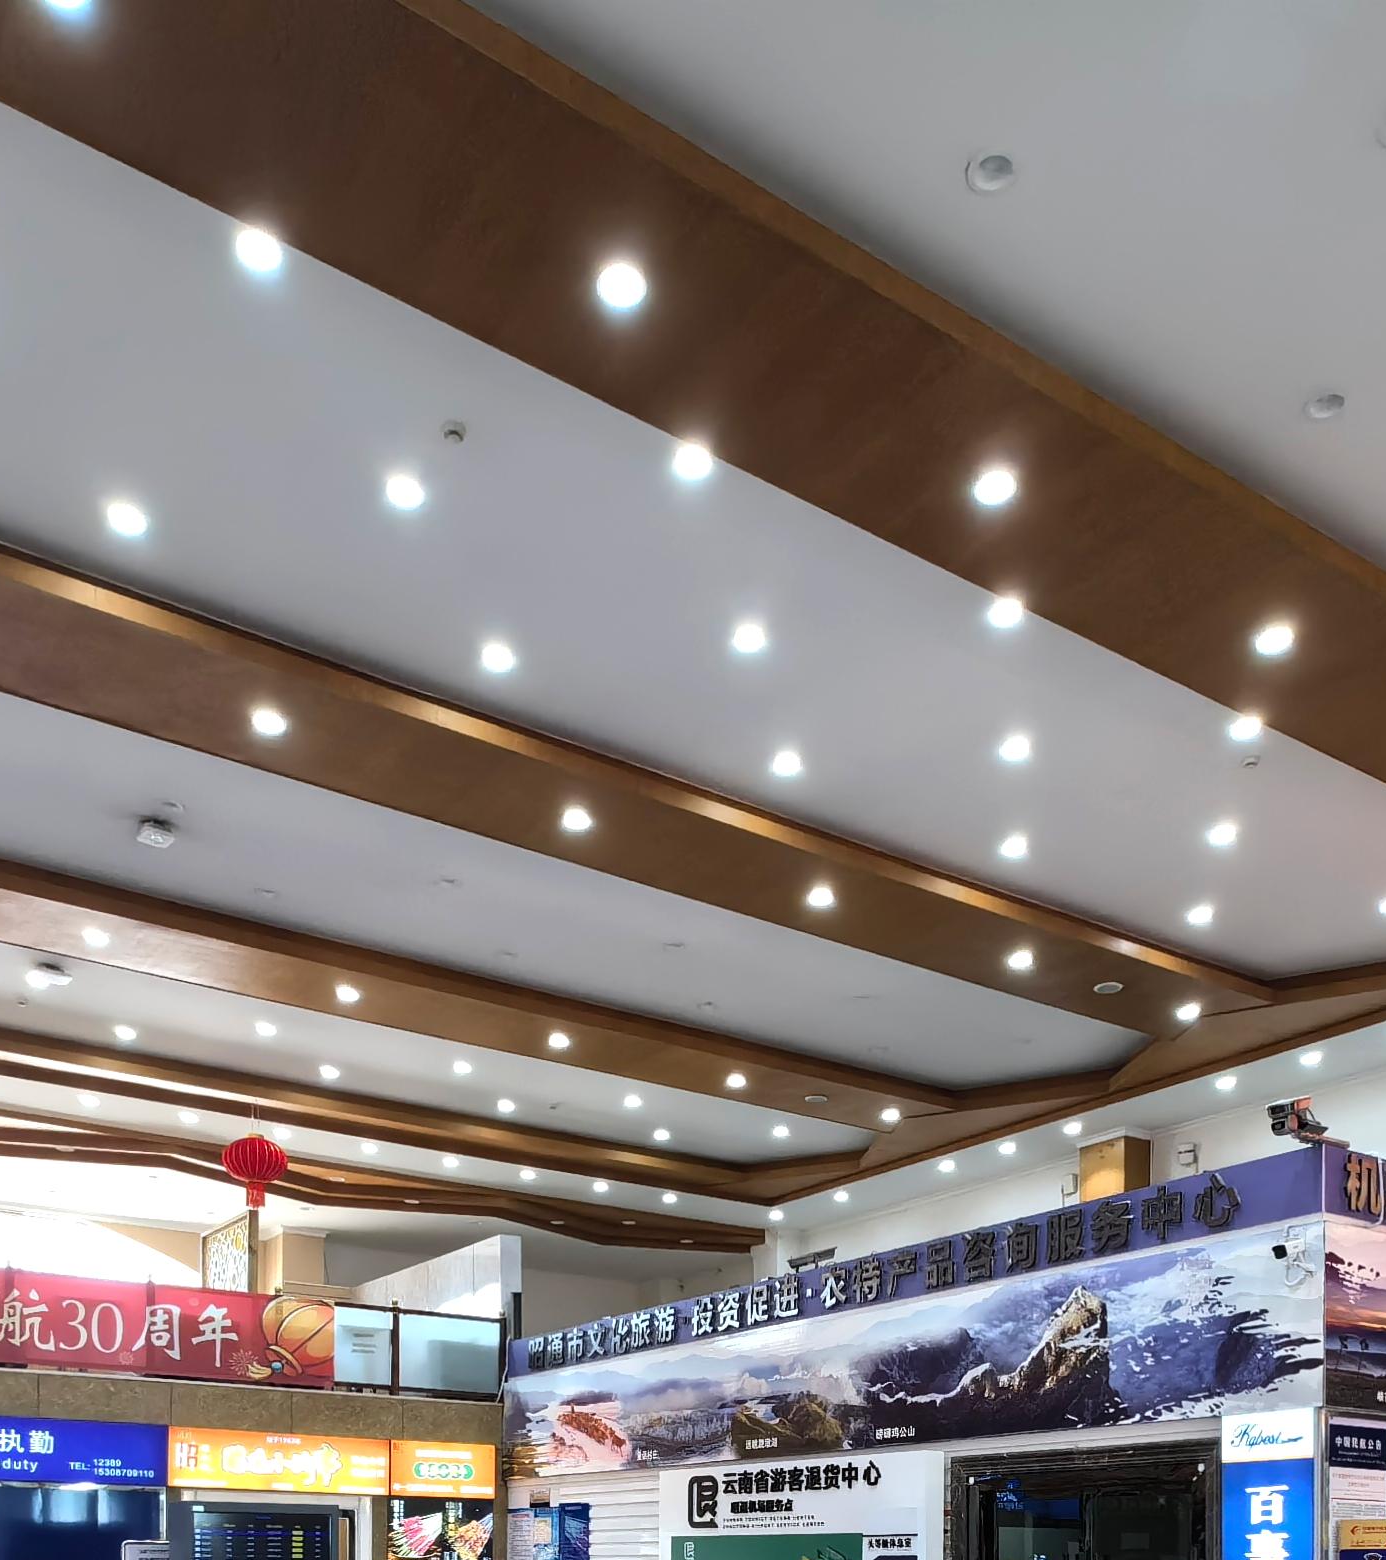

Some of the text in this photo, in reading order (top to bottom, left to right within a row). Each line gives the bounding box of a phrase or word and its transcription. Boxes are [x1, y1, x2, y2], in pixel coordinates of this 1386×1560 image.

[92, 1458, 122, 1468] 12389
[721, 1460, 882, 1495] 云南省游客退货中心
